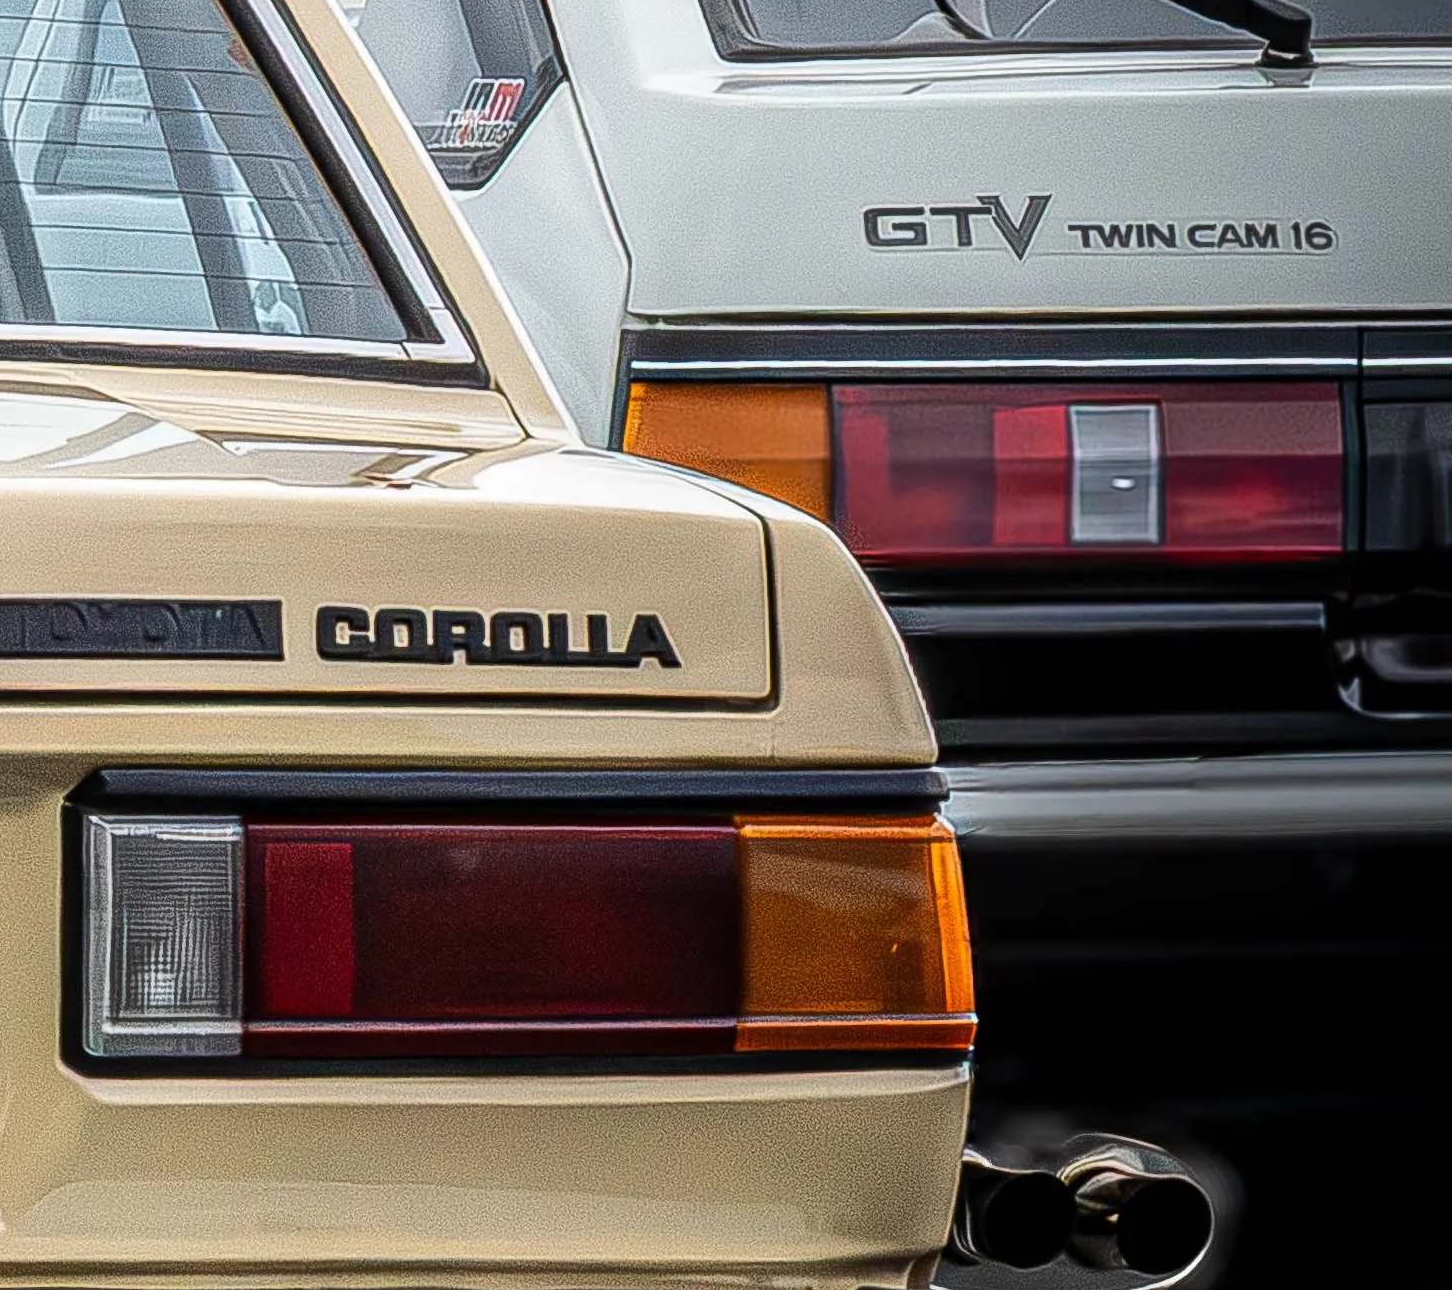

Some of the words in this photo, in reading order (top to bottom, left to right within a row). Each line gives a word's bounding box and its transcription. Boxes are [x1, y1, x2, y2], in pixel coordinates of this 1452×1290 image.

[863, 193, 1052, 261] GTV
[1067, 222, 1177, 249] TWIN
[1187, 222, 1280, 249] CAM
[1290, 221, 1334, 250] 16
[315, 604, 683, 669] COROLLA
